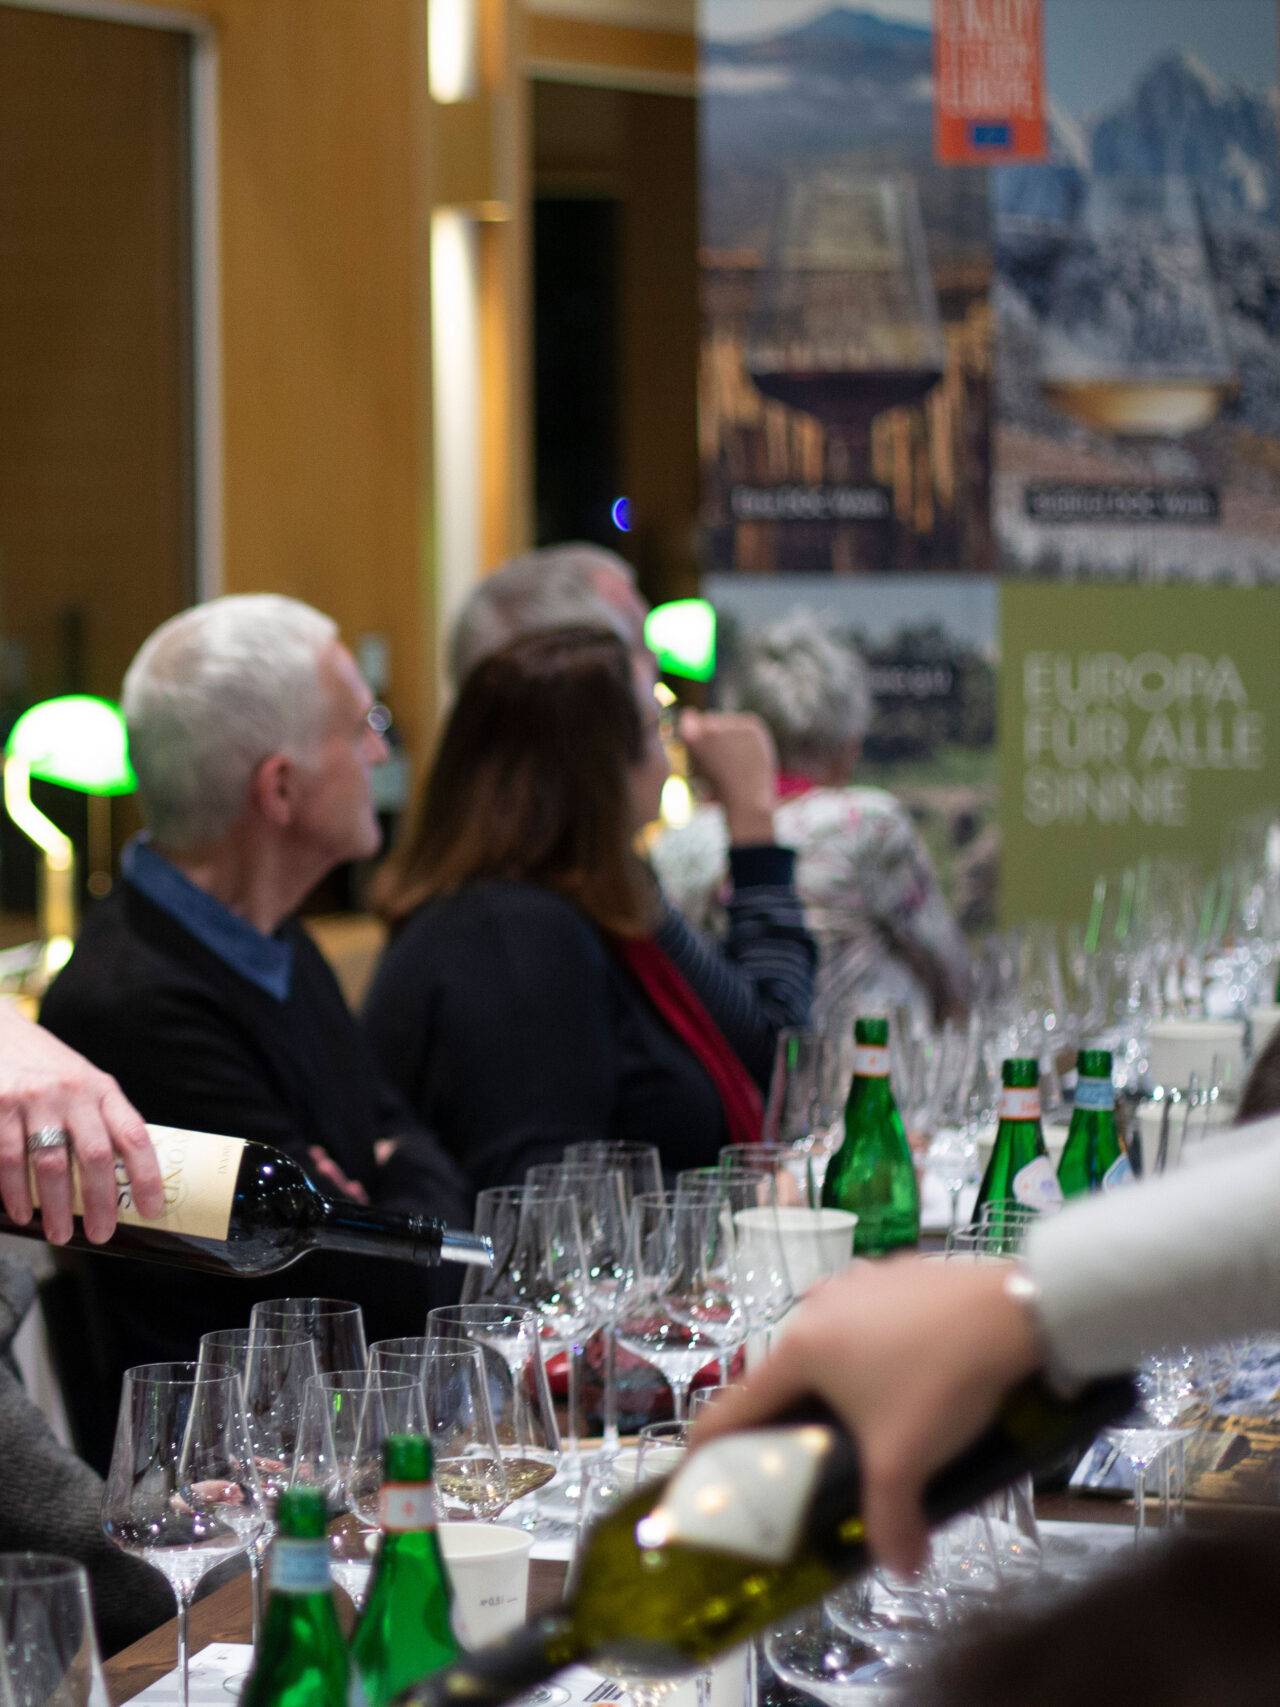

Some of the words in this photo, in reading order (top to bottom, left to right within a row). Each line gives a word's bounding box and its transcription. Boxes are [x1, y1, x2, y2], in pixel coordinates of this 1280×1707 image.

[1024, 654, 1247, 707] EUROPA
[1138, 712, 1266, 767] ALLE
[1024, 770, 1189, 823] SINNE
